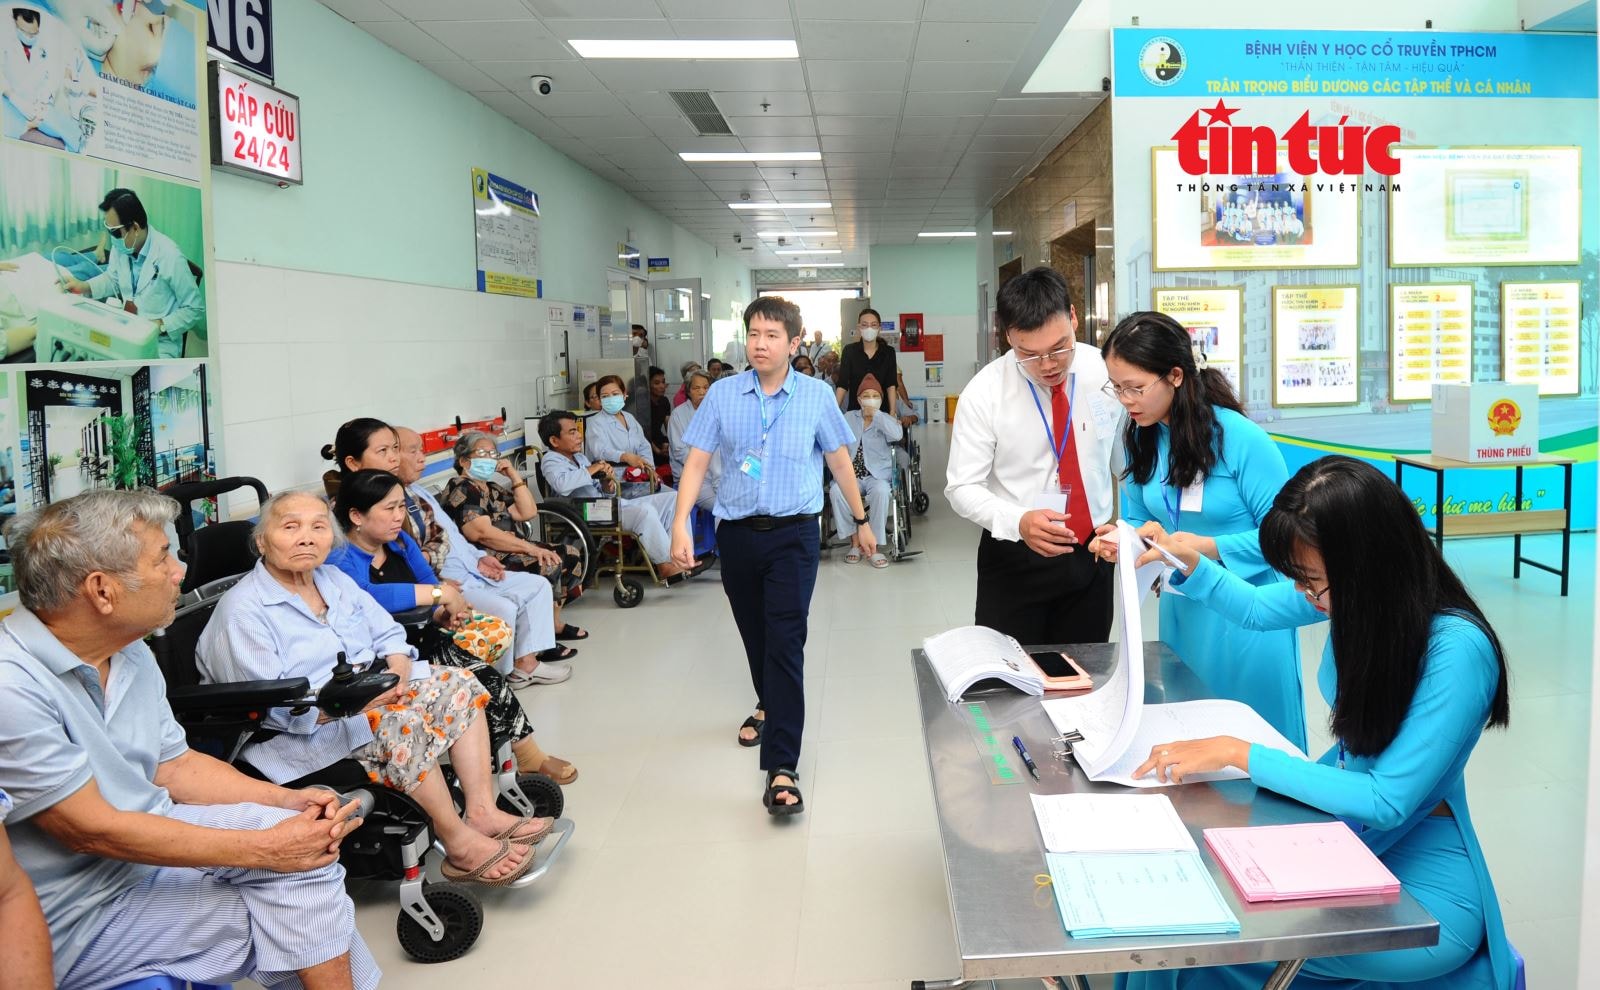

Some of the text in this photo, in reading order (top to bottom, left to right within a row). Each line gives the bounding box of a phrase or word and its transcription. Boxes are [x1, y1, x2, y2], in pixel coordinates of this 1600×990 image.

[1245, 38, 1497, 59] BỆNH VIỆN Y HỌC CỔ TRUYỀN TPHCM
[1412, 61, 1434, 74] HIỆU
[1206, 74, 1531, 96] TRÂN TRỌNG BIỂU DƯƠNG CÁC TẬP THỂ VÀ CÁ NHÂN
[225, 82, 295, 142] CẤP CỨU
[233, 130, 290, 172] 24/24
[1477, 444, 1532, 458] THÙNG PHIẾU
